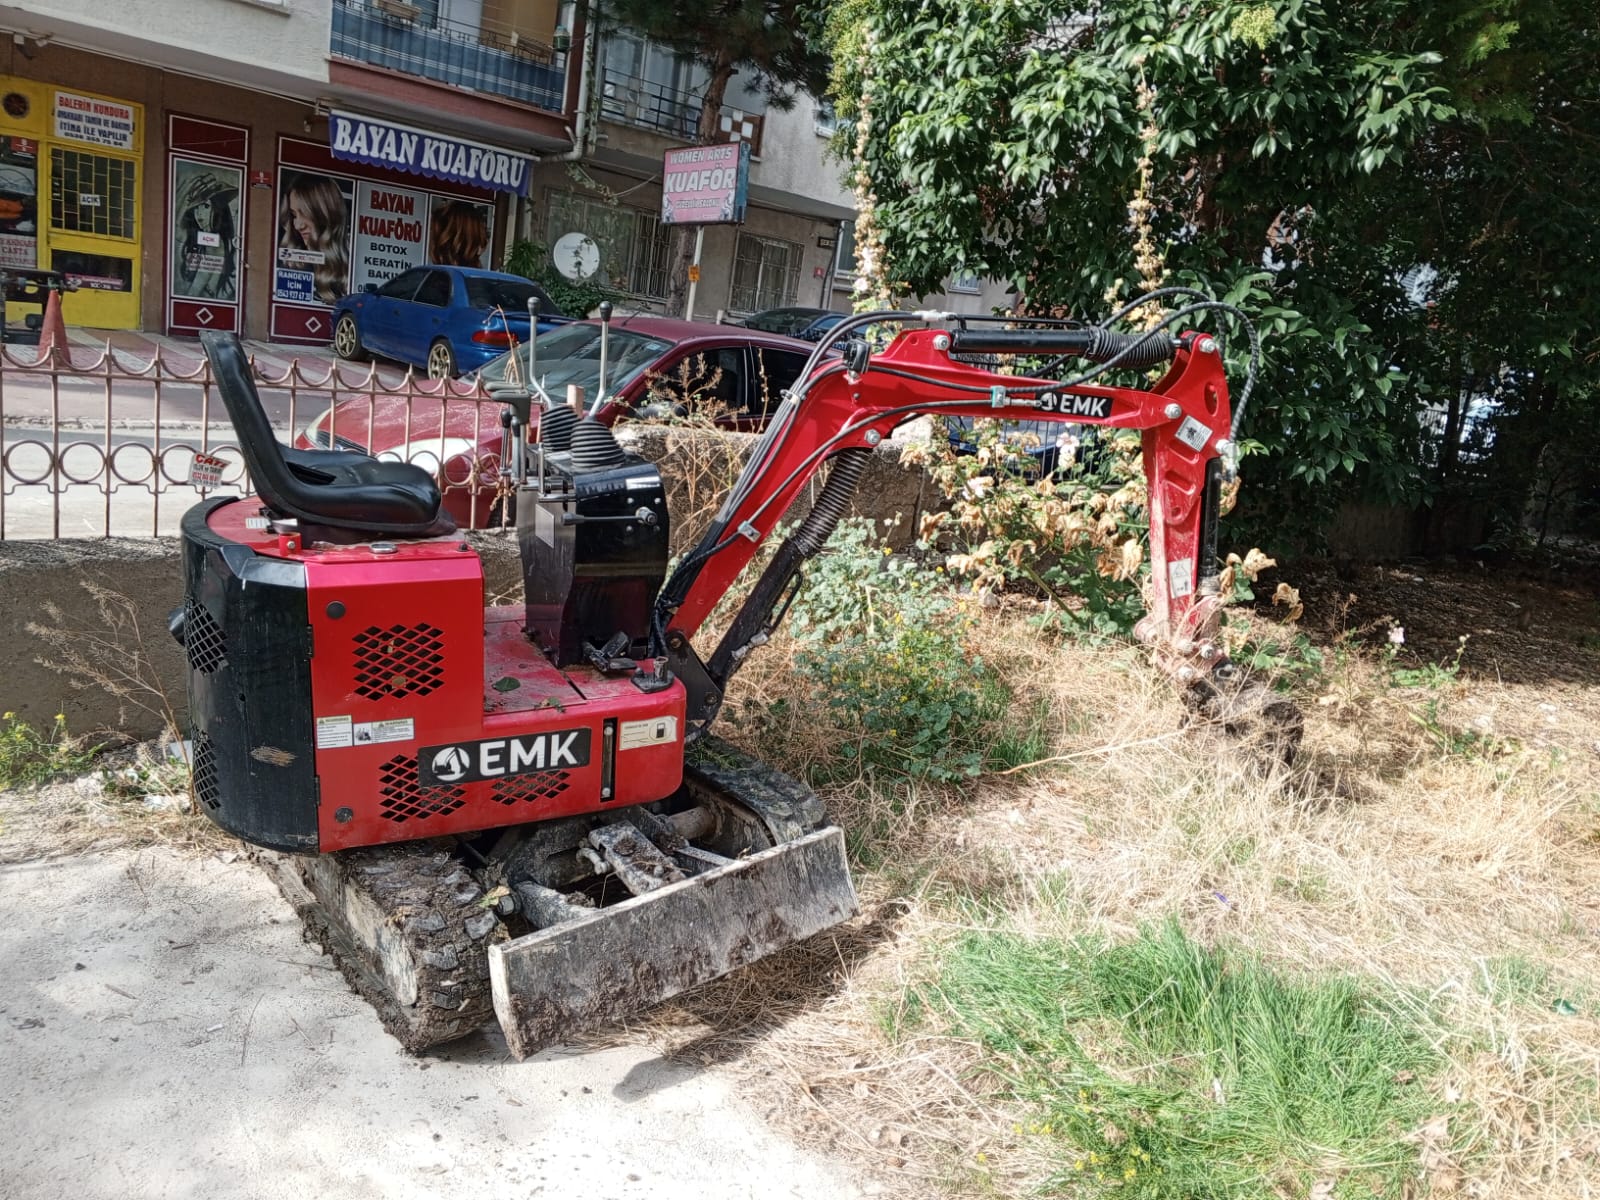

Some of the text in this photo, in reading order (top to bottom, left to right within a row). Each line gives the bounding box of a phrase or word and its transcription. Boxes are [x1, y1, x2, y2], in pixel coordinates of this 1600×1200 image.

[333, 118, 418, 165] BAYAN
[670, 147, 732, 165] WOMEN ARTS
[664, 163, 737, 193] KUAFÖR
[370, 189, 415, 216] BAYAN
[359, 215, 422, 243] KUAFÖRÜ
[370, 242, 407, 255] BOTOX
[364, 256, 412, 270] KERATİN
[278, 271, 312, 282] RANDEVU
[1060, 394, 1108, 418] EMK
[479, 731, 579, 777] EMK
